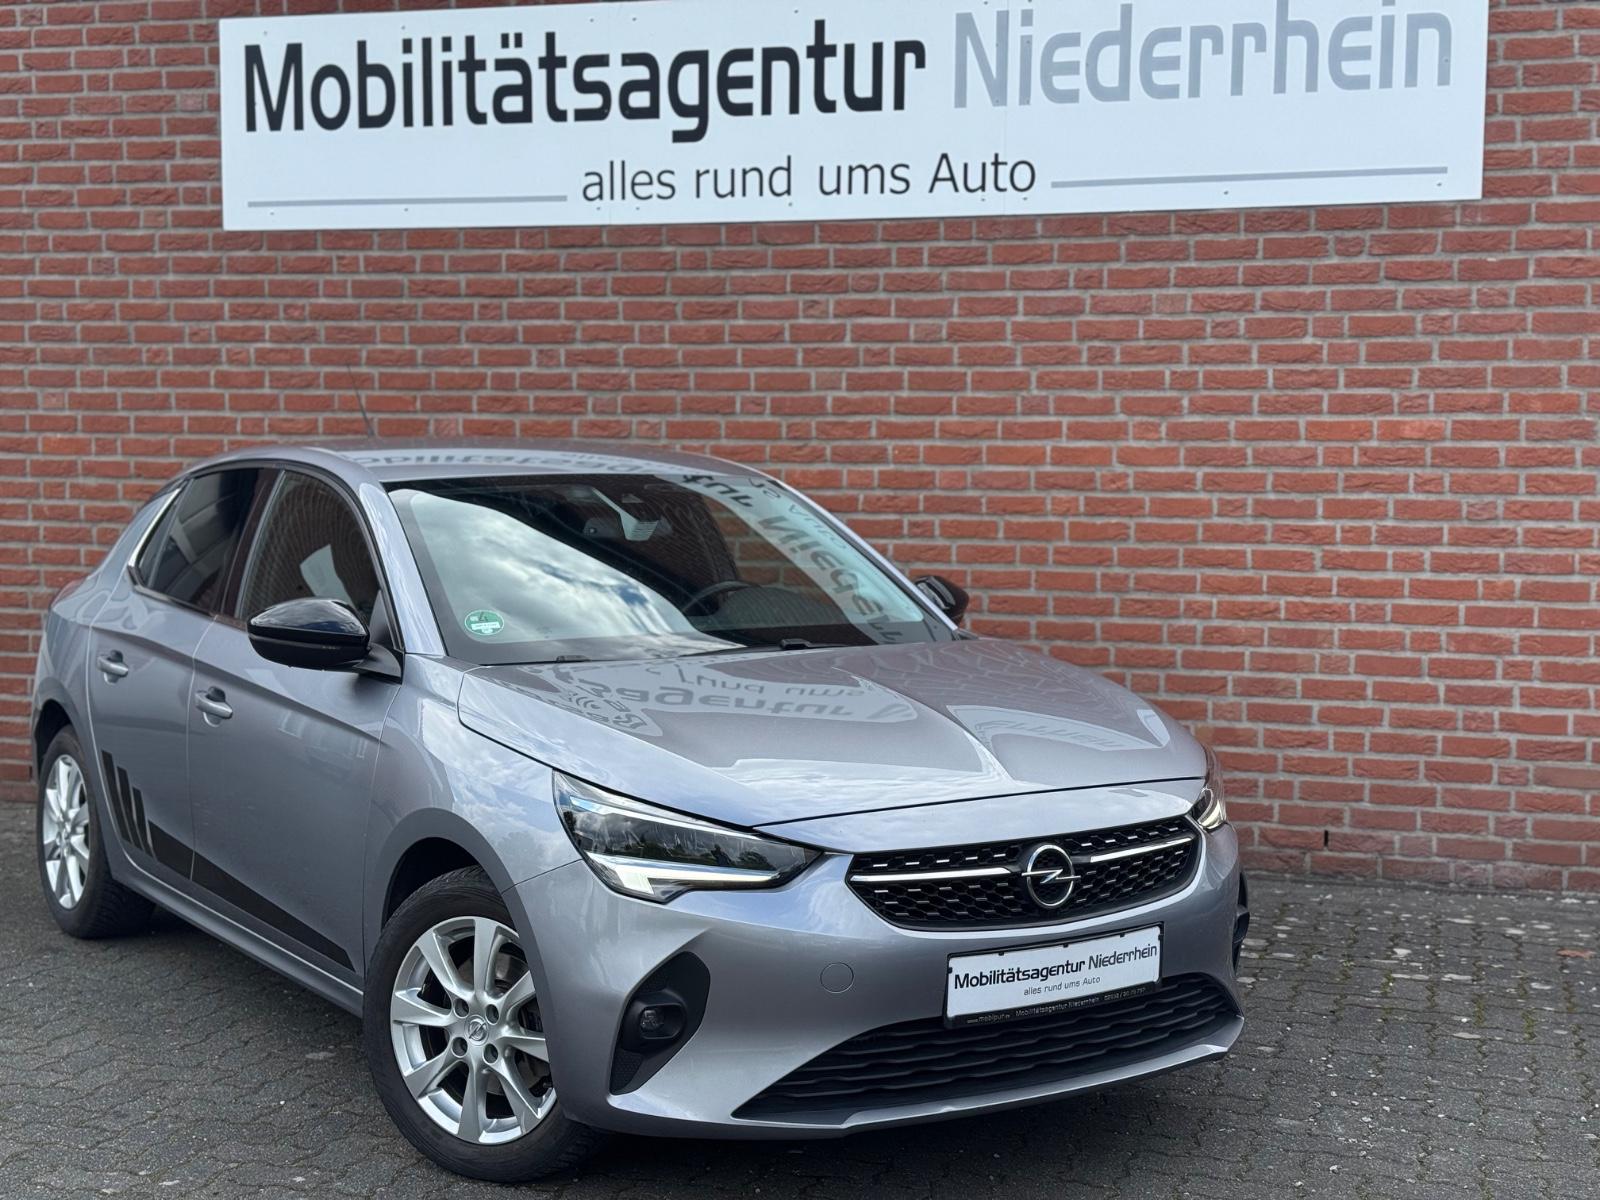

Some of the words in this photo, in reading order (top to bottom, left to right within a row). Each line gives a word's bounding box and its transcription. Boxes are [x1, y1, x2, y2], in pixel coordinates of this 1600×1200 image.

[244, 19, 926, 144] Mobilitätsagentur
[953, 0, 1453, 109] Niederrhein
[582, 160, 677, 202] alles
[694, 155, 792, 198] rund
[817, 162, 911, 196] ums
[928, 152, 1036, 194] Auto
[954, 959, 1085, 989] Mobilitätsagentur
[1088, 944, 1158, 970] Niederrhein
[1024, 986, 1042, 996] alles
[1044, 983, 1062, 992] rund
[1064, 979, 1080, 989] ums
[1082, 975, 1101, 986] Auto
